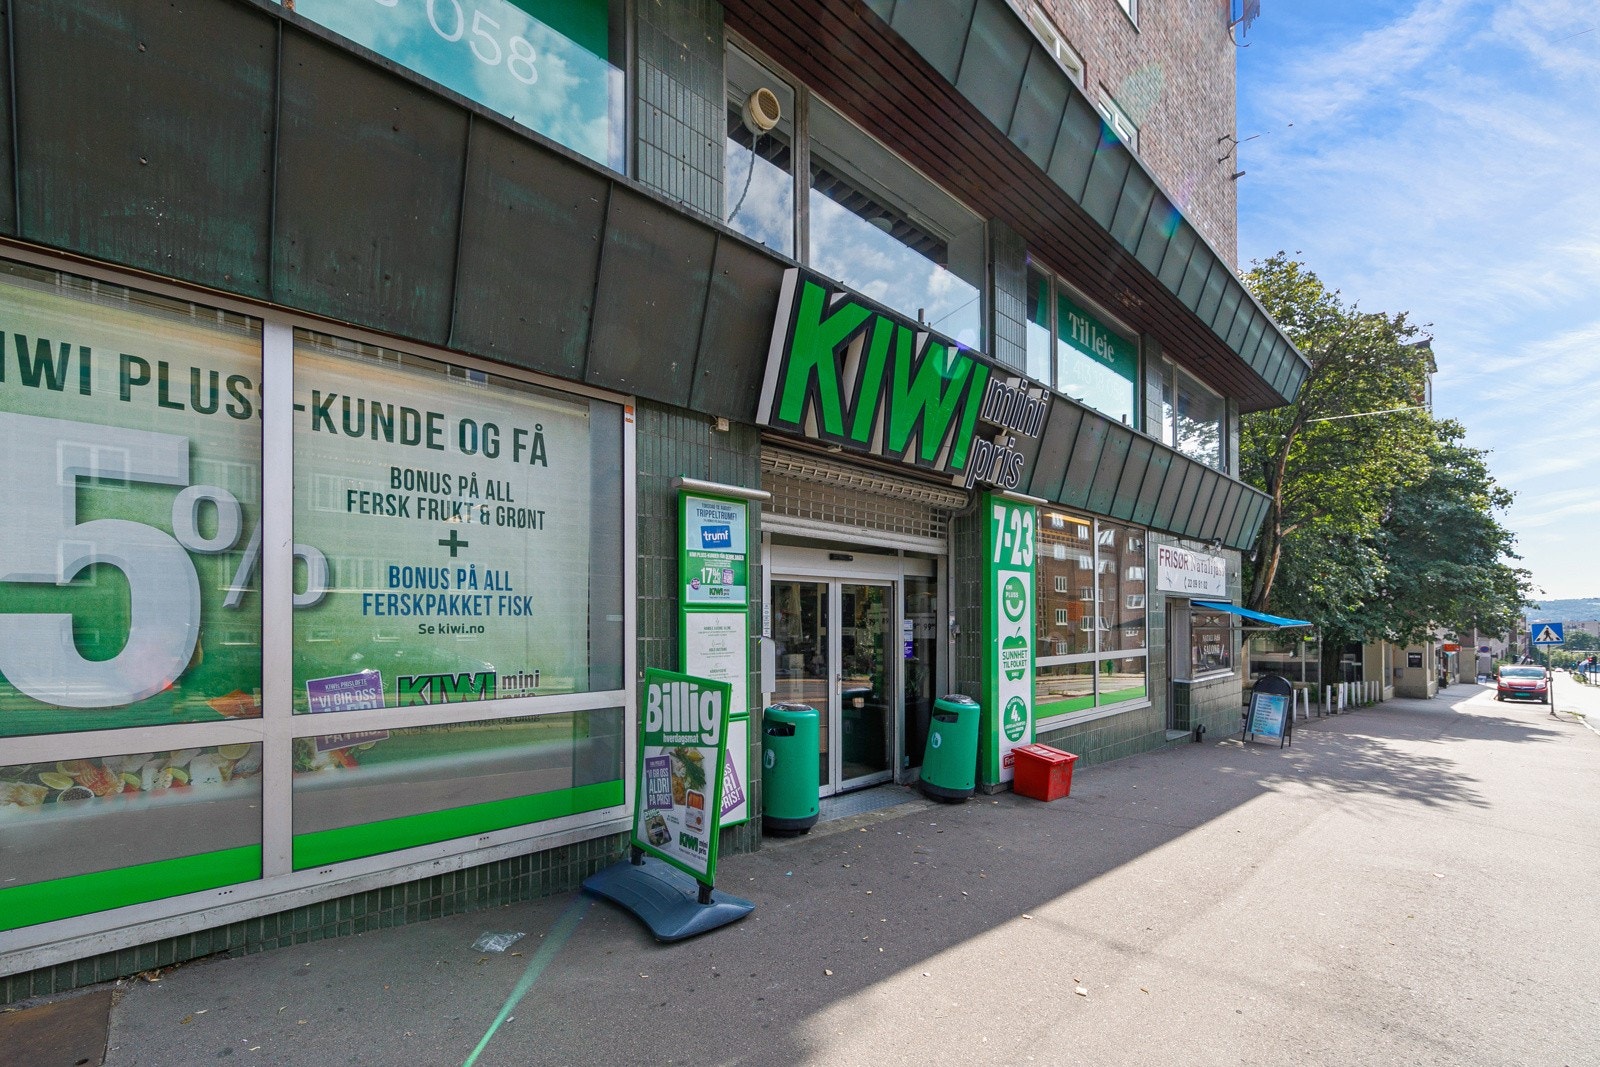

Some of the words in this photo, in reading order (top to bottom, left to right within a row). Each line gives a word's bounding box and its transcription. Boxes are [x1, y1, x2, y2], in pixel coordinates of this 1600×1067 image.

[1068, 311, 1090, 348] Til
[1091, 325, 1115, 363] leie
[775, 276, 993, 473] KIWI
[983, 378, 1050, 439] mini
[458, 417, 500, 460] OG
[513, 423, 548, 468] FÅ
[966, 436, 1025, 490] pris
[390, 466, 452, 496] BONUS
[458, 471, 480, 499] PÅ
[485, 479, 515, 503] ALL
[346, 489, 410, 518] FERSK
[417, 496, 474, 524] FRUKT
[479, 504, 491, 526] &
[496, 505, 546, 531] GRØNT
[703, 530, 729, 541] trumf
[993, 504, 1034, 568] 7-23
[1159, 547, 1189, 571] FRISØR
[388, 565, 450, 590] BONUS
[457, 564, 478, 591] PÅ
[484, 569, 513, 592] ALL
[362, 592, 493, 616] FERSKPAKKET
[498, 595, 534, 617] FISK
[418, 623, 436, 635] Se
[438, 622, 485, 635] kiwi.no
[1002, 649, 1028, 660] SUNNHET
[1010, 659, 1027, 668] FOLKET
[333, 691, 353, 706] GIR
[354, 687, 376, 702] OSS
[397, 672, 497, 707] KIWI
[501, 669, 540, 690] mini
[645, 681, 722, 746] Billig
[663, 733, 699, 745] hverdagsmat
[649, 777, 670, 794] ALDRI
